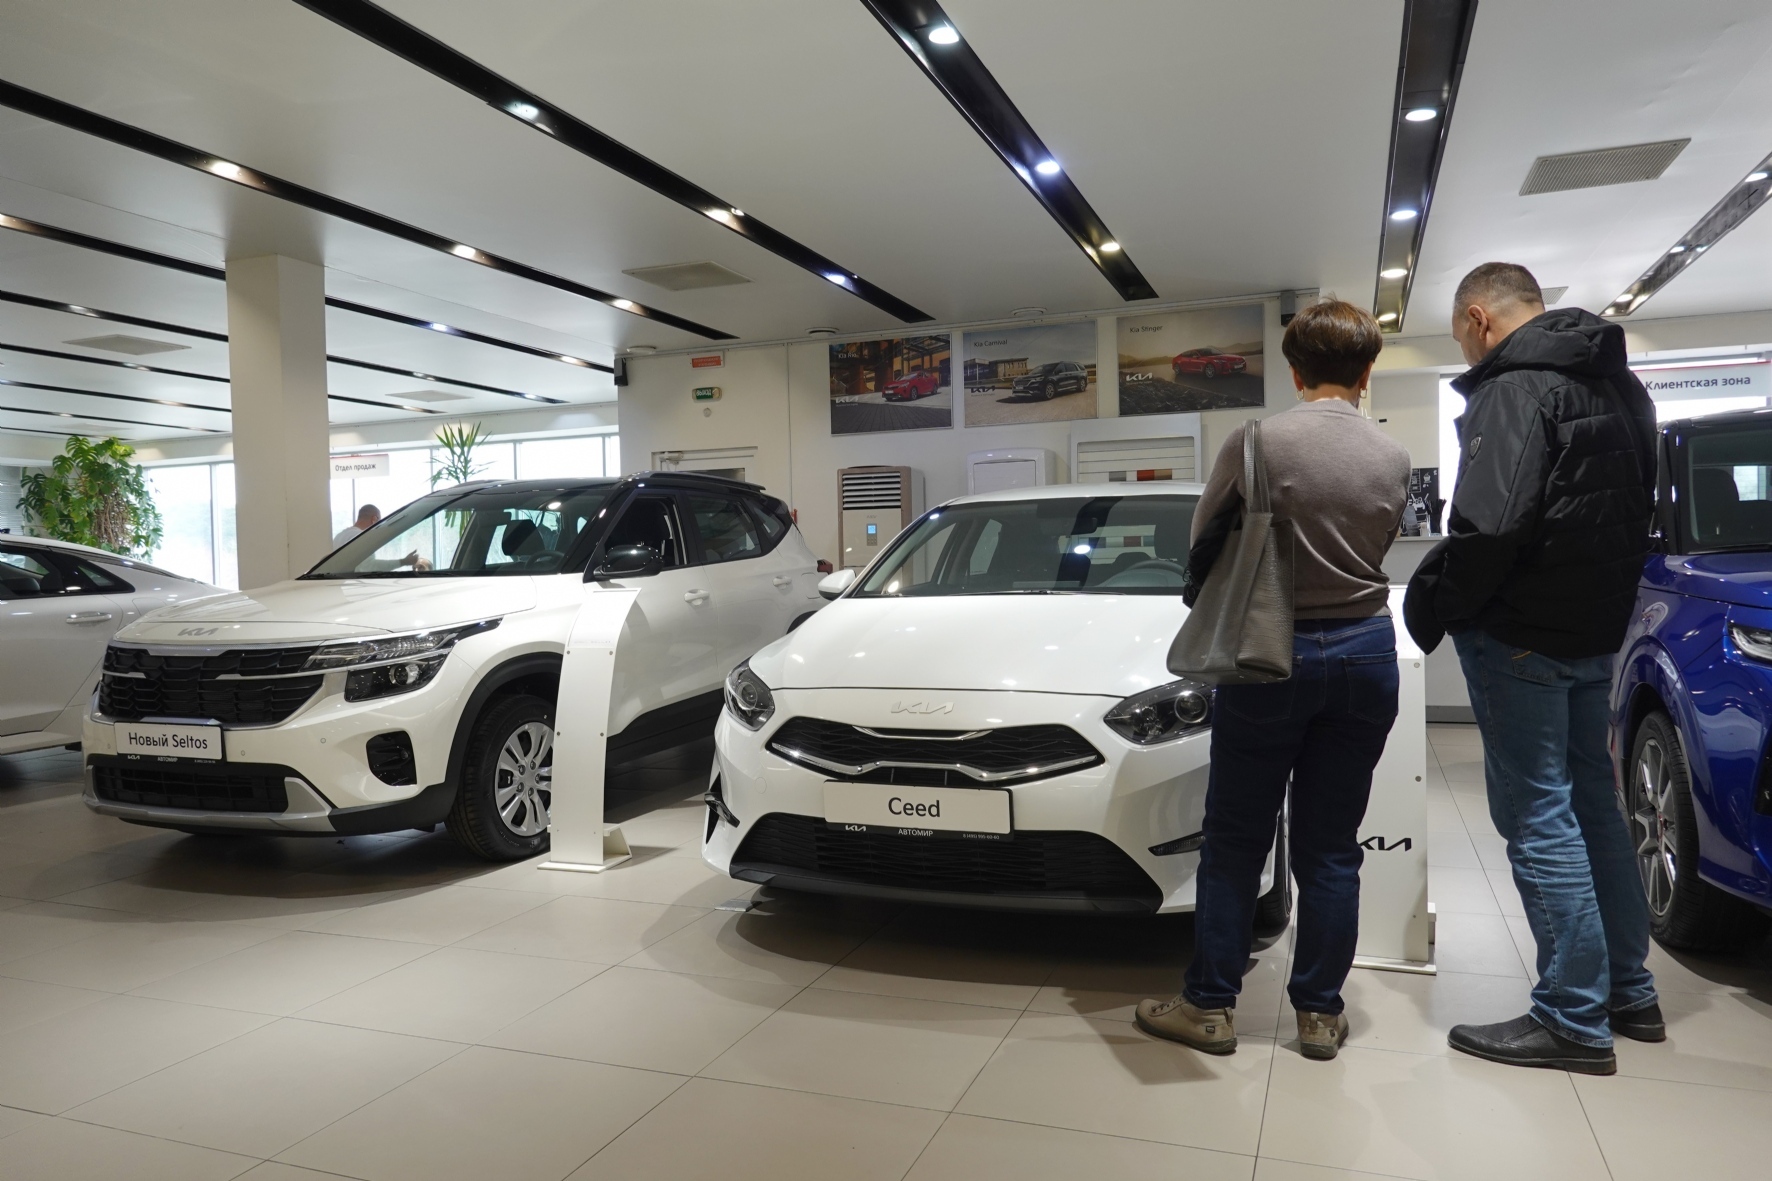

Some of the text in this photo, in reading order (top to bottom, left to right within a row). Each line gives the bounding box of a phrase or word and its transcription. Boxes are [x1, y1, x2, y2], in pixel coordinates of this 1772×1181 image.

[1140, 325, 1163, 333] Stinger
[984, 339, 1008, 347] Carnival
[1125, 372, 1153, 381] KIA
[1645, 376, 1751, 390] Клиентская зона
[971, 385, 996, 393] KIA
[835, 396, 859, 404] KIA
[335, 463, 377, 472] Отдел продаж
[177, 627, 219, 636] KIA
[890, 701, 955, 715] KIA
[128, 732, 208, 749] Новый Seltos
[888, 797, 941, 817] Ceed
[845, 824, 867, 832] KIA
[898, 828, 934, 837] АВТОМИР
